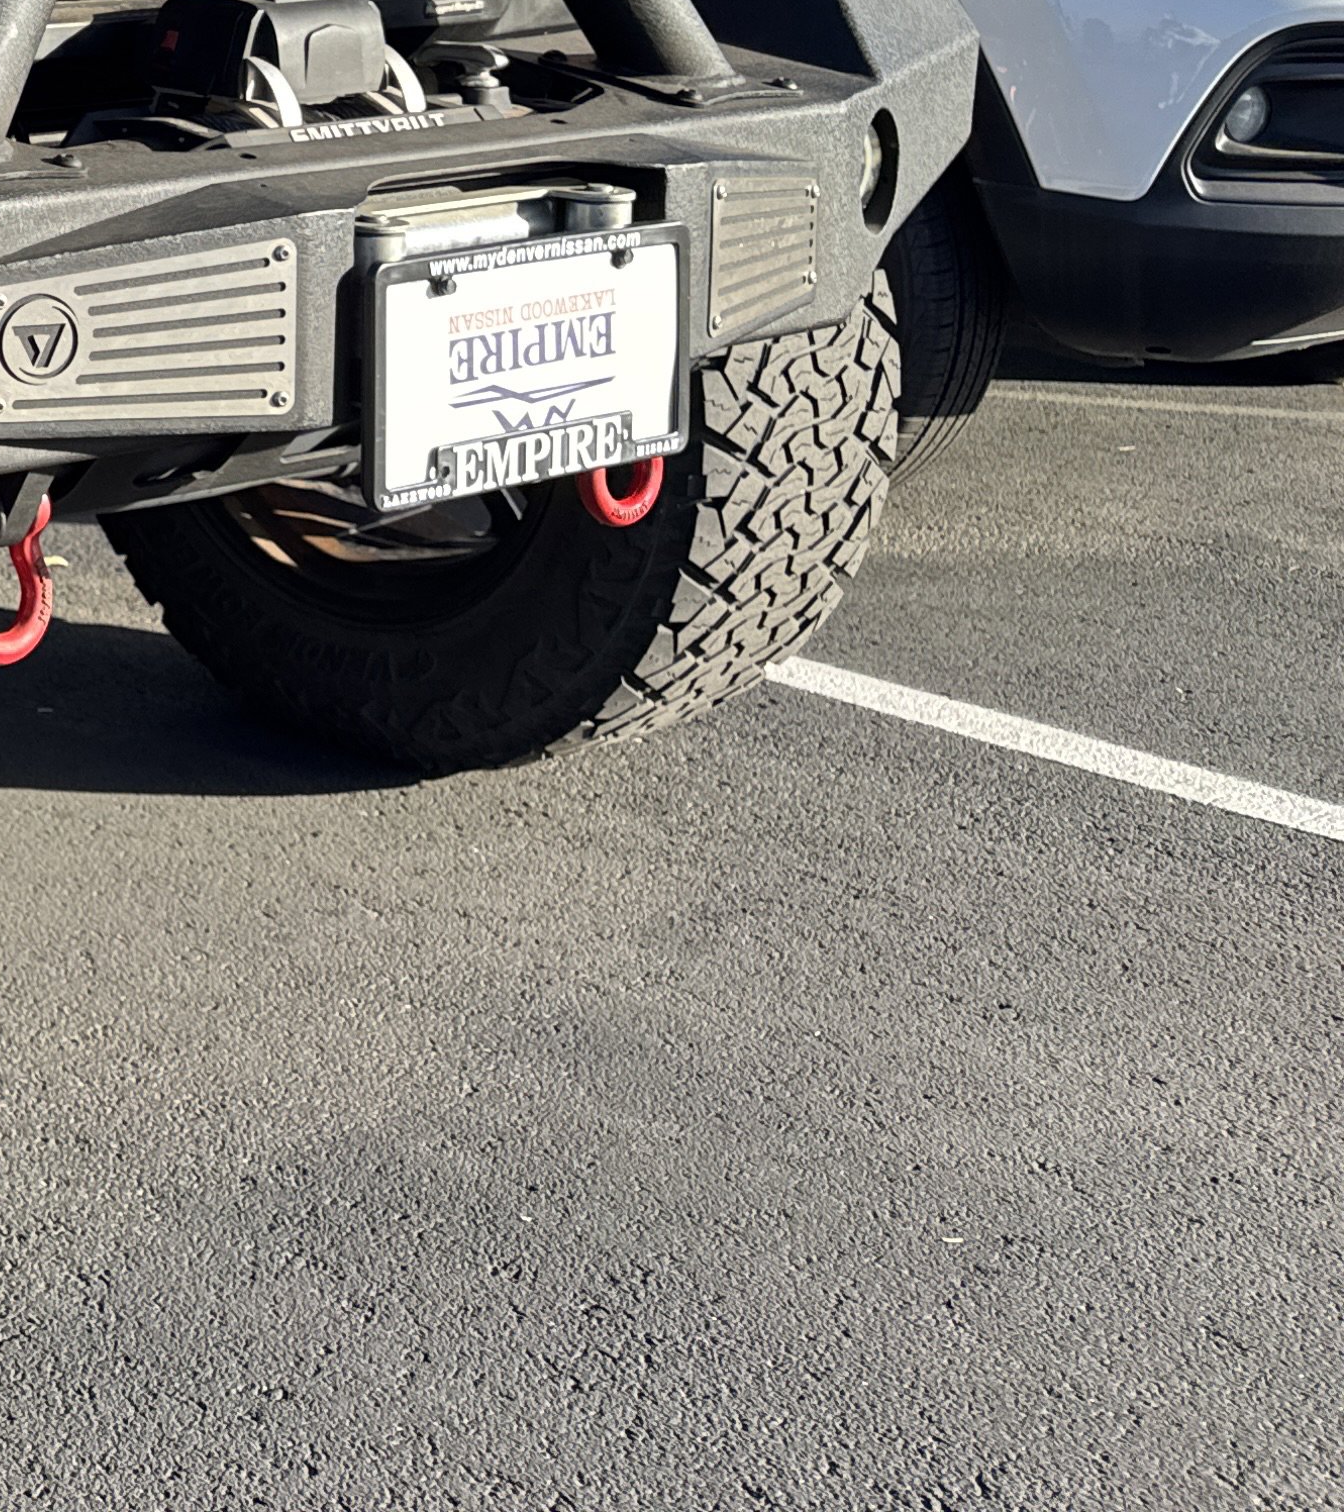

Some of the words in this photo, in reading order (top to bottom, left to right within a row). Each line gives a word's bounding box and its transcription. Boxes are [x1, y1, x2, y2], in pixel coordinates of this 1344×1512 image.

[429, 231, 641, 277] www.mydenvernissan.com
[448, 306, 514, 335] NISSAN
[520, 288, 616, 321] LAKEWOOD
[449, 310, 616, 385] EMPIRE
[452, 414, 623, 497] EMPIRE
[636, 437, 680, 457] NISSAN
[381, 483, 452, 509] LAKEWOOD
